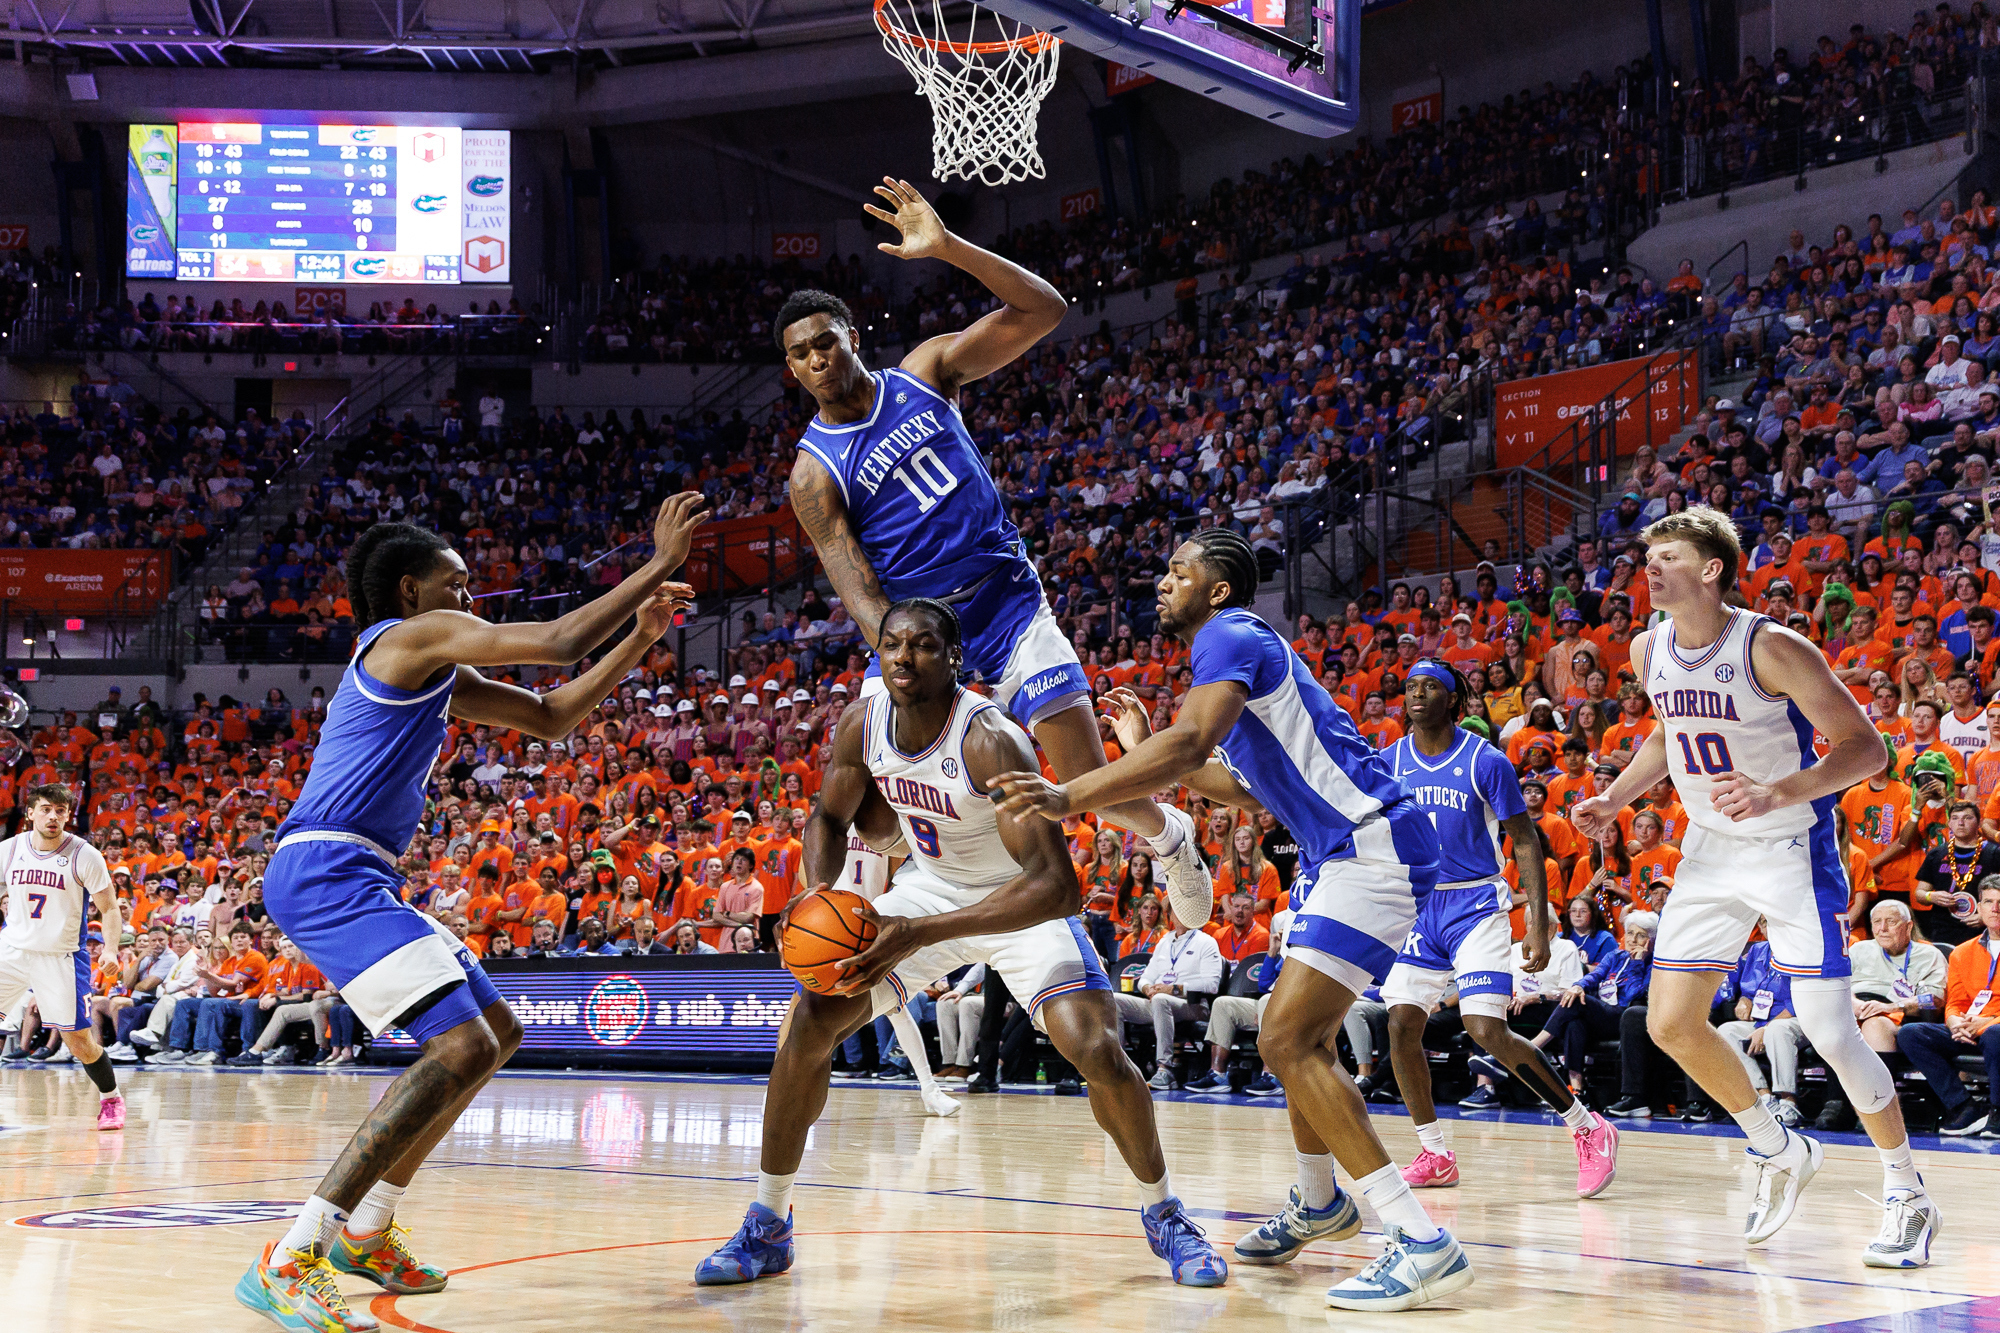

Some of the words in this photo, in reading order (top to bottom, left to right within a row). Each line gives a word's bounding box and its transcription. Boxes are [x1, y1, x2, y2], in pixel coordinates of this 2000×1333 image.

[1402, 100, 1431, 126] 211
[465, 138, 505, 147] PROUD
[340, 146, 358, 160] 22
[465, 149, 505, 157] PARTNER
[465, 159, 478, 167] OF
[484, 159, 505, 167] THE
[223, 180, 241, 194] 12
[344, 182, 354, 196] 7
[208, 197, 228, 213] 27
[1065, 194, 1095, 218] 210
[465, 213, 505, 228] LAW
[210, 233, 227, 248] 11
[776, 237, 817, 254] 209
[130, 248, 147, 260] GO
[130, 260, 174, 272] GATORS
[220, 255, 249, 275] 54
[299, 255, 340, 270] 12:44
[203, 266, 211, 277] 7
[1502, 389, 1541, 402] SECTION
[1524, 404, 1539, 417] 111
[1655, 408, 1669, 421] 13
[1524, 432, 1534, 443] 11
[856, 410, 944, 496] KENTUCKY
[893, 447, 957, 514] 10
[8, 568, 26, 577] 107
[7, 587, 21, 596] 07
[65, 583, 103, 591] ARENA
[1716, 664, 1734, 683] SEC
[1024, 670, 1069, 700] Wildcats
[1654, 689, 1741, 722] FLORIDA
[1676, 732, 1734, 775] 10
[941, 758, 958, 779] SEC
[874, 776, 961, 821] FLORIDA
[1412, 785, 1468, 812] NTUCKY
[1881, 803, 1894, 845] GATORS
[907, 814, 942, 859] 9
[11, 869, 66, 891] FLORIDA
[853, 860, 863, 885] 1
[28, 893, 47, 919] 7
[1402, 931, 1424, 957] K
[1457, 975, 1492, 991] Wildcats
[655, 1000, 672, 1025] a
[677, 994, 725, 1025] sub
